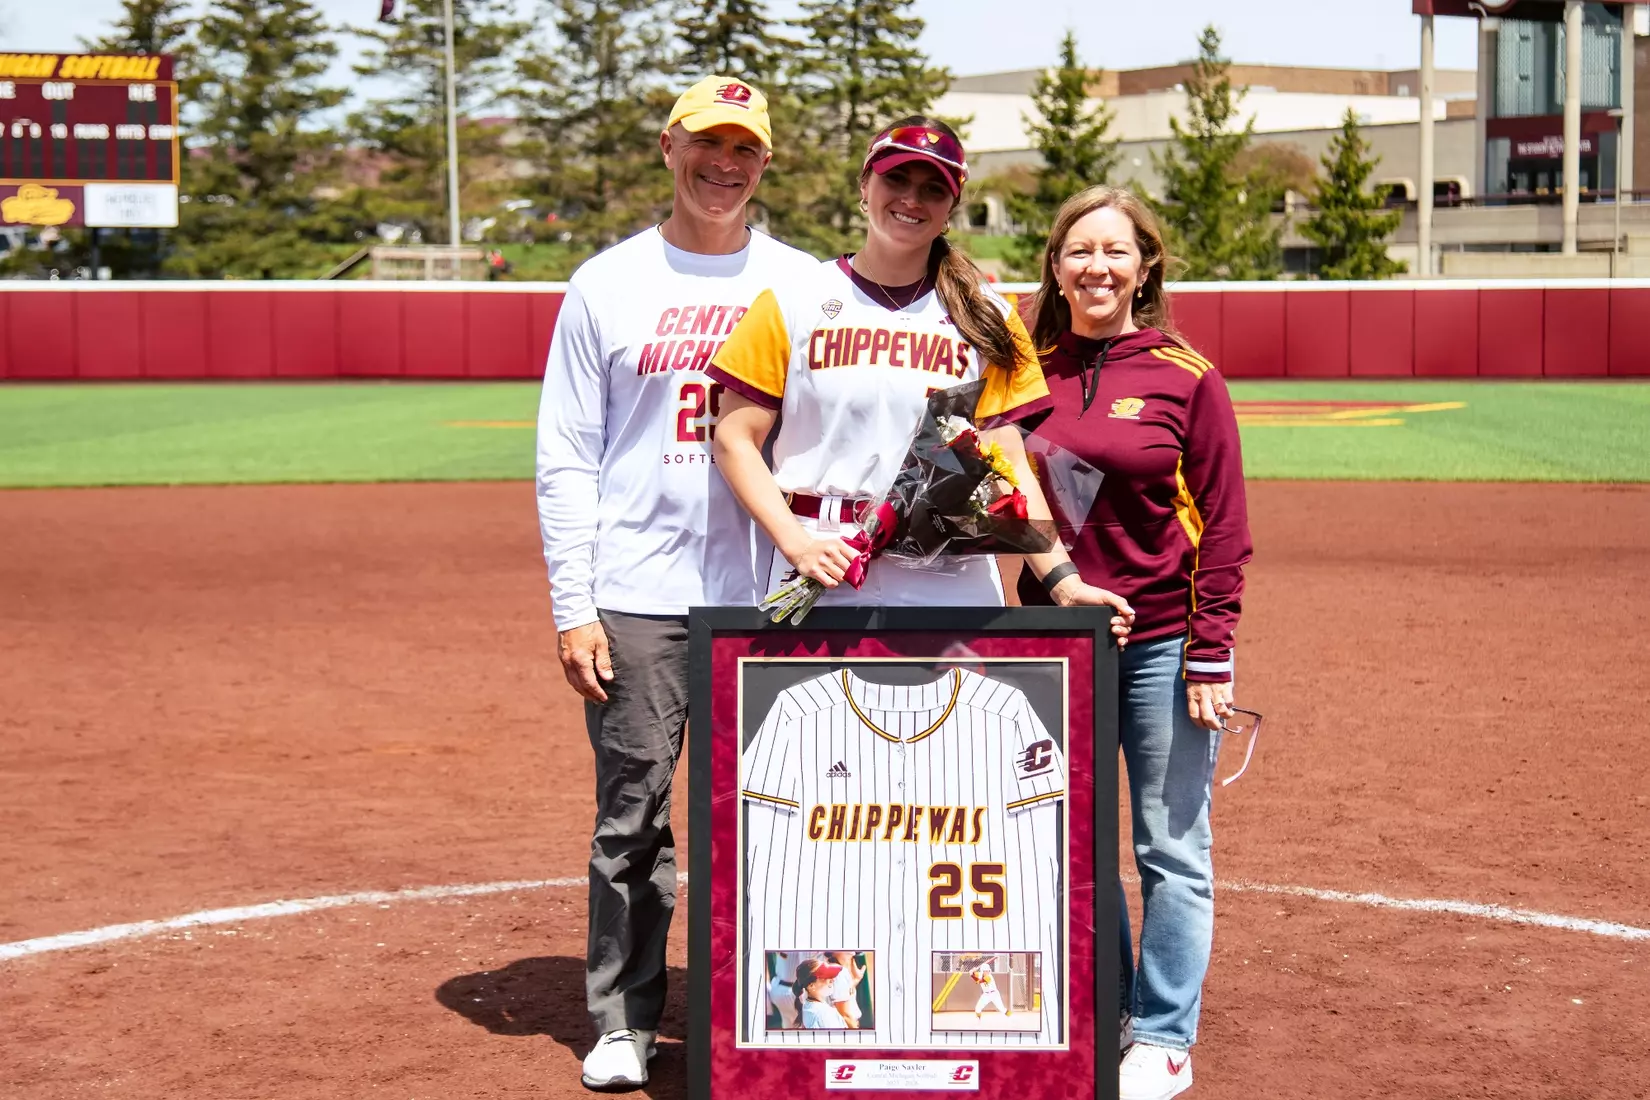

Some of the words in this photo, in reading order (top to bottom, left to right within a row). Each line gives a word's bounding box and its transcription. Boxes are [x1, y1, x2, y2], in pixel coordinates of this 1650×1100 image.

[808, 327, 971, 380] CHIPPEWAS
[807, 803, 988, 845] CHIPPEWAS
[927, 861, 1006, 920] 25
[879, 1063, 899, 1072] Paige
